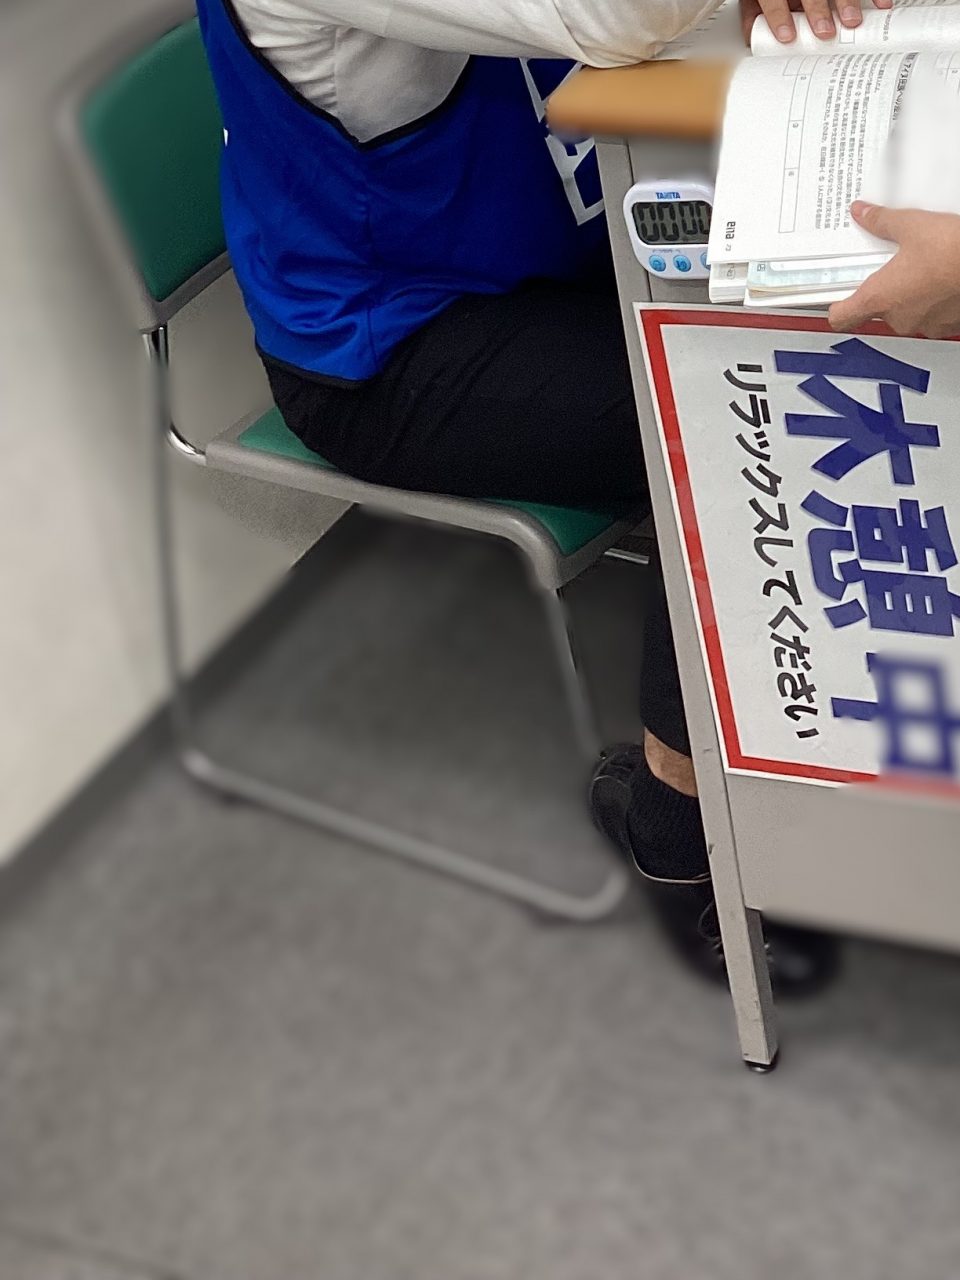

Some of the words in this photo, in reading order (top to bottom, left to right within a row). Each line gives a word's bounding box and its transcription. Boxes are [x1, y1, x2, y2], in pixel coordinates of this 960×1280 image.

[725, 220, 736, 240] ena
[723, 362, 820, 741] リラックスしてください
